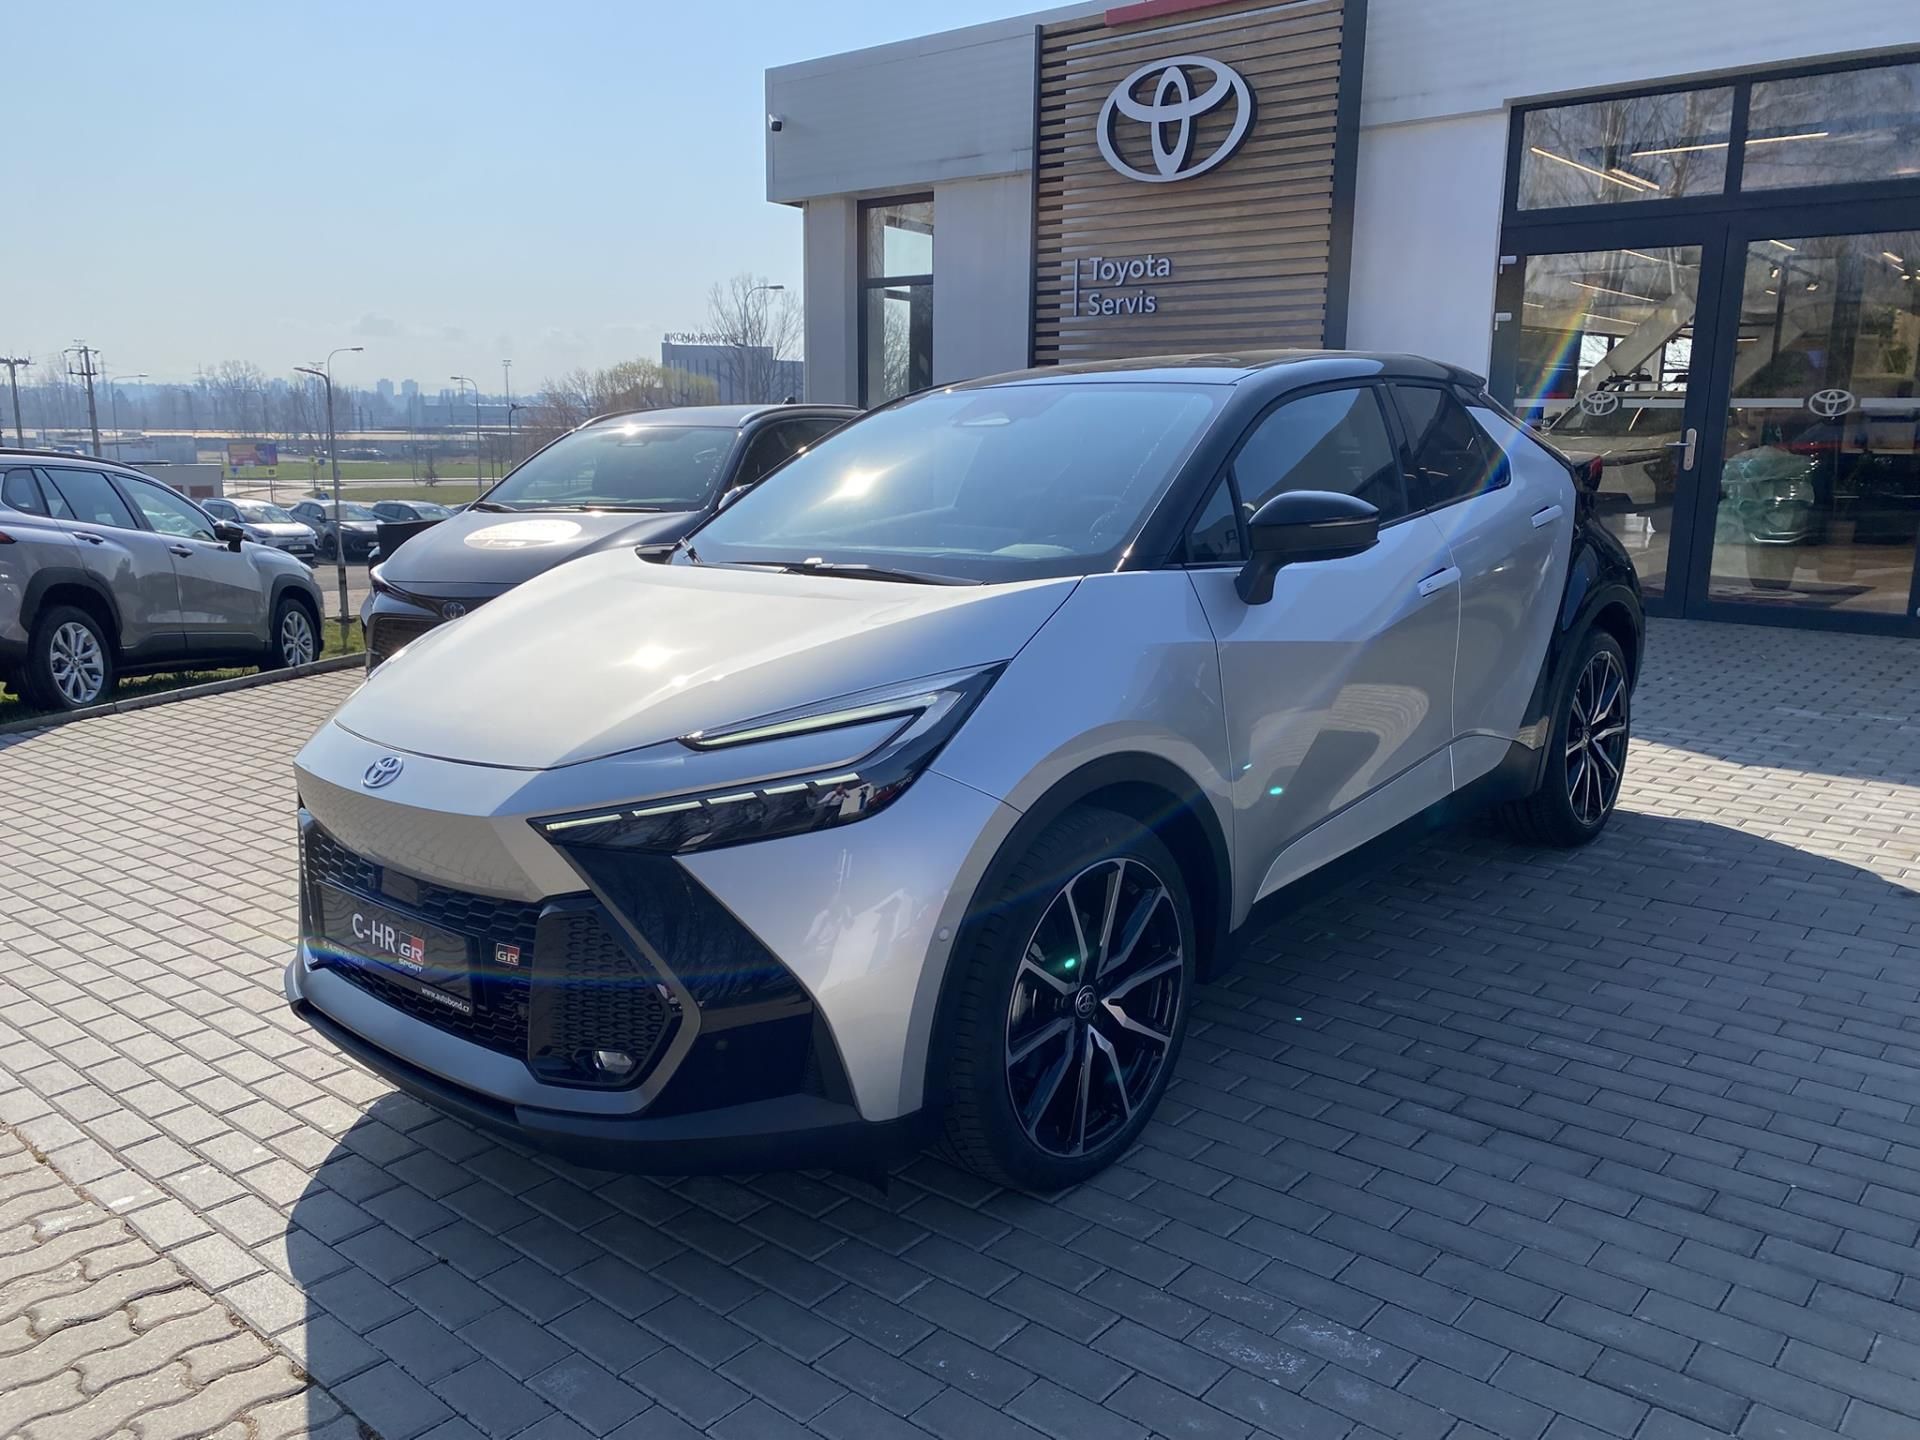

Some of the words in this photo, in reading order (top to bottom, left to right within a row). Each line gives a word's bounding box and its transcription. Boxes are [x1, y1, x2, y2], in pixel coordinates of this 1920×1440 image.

[1088, 255, 1171, 286] Toyota
[1087, 290, 1157, 316] Servis
[352, 912, 396, 954] C-HR
[399, 942, 424, 962] GR
[399, 957, 423, 973] SPORT
